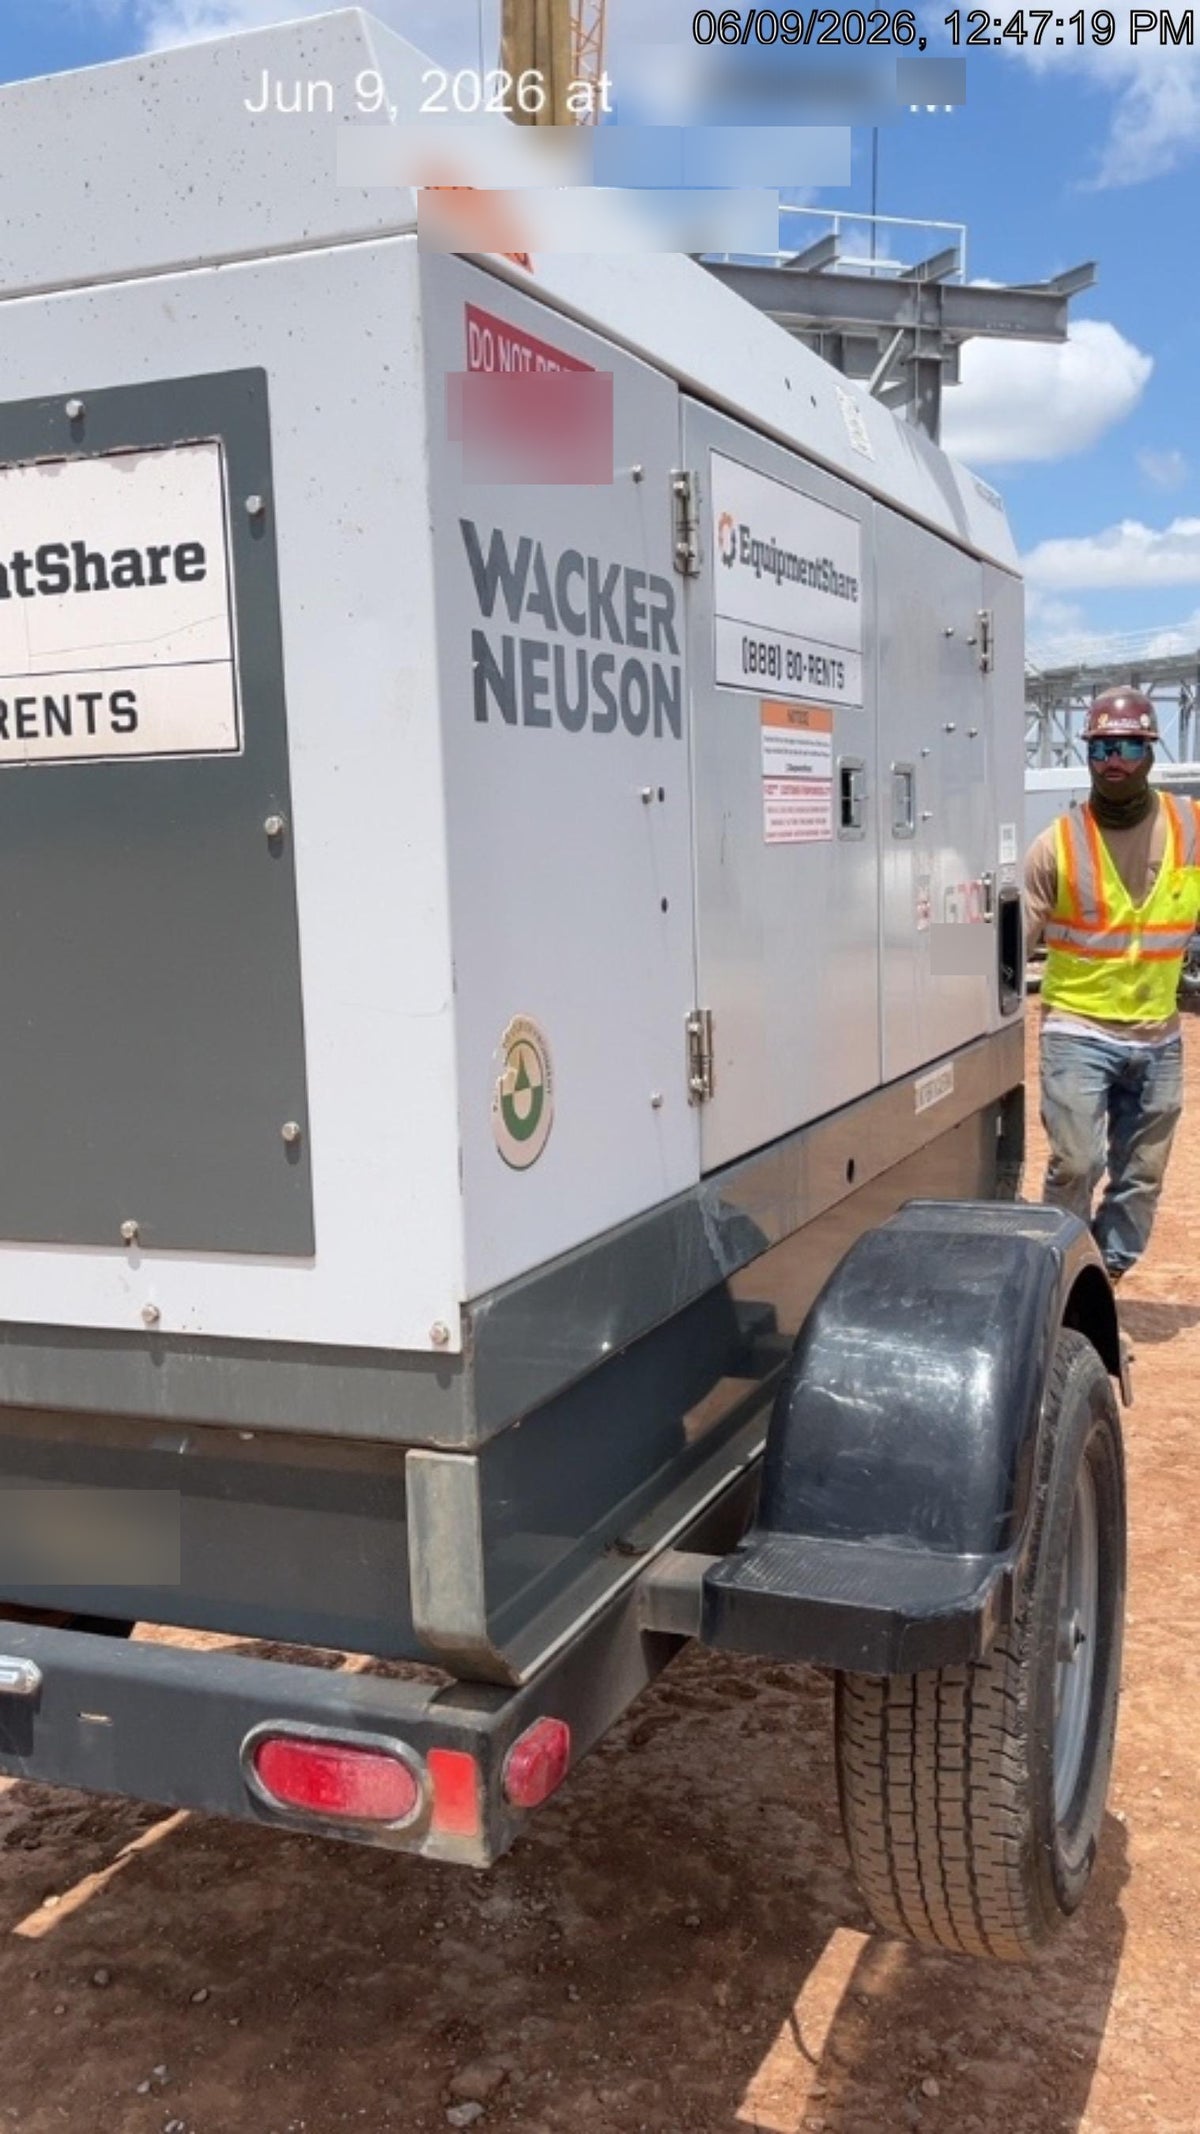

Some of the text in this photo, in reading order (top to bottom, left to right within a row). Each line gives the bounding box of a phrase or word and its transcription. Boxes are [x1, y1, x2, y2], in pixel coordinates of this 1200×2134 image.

[469, 320, 494, 372] DO
[459, 519, 680, 655] WACKER
[739, 524, 858, 602] EquipmentShare
[471, 629, 682, 739] NEUSON
[742, 635, 781, 681] (888)
